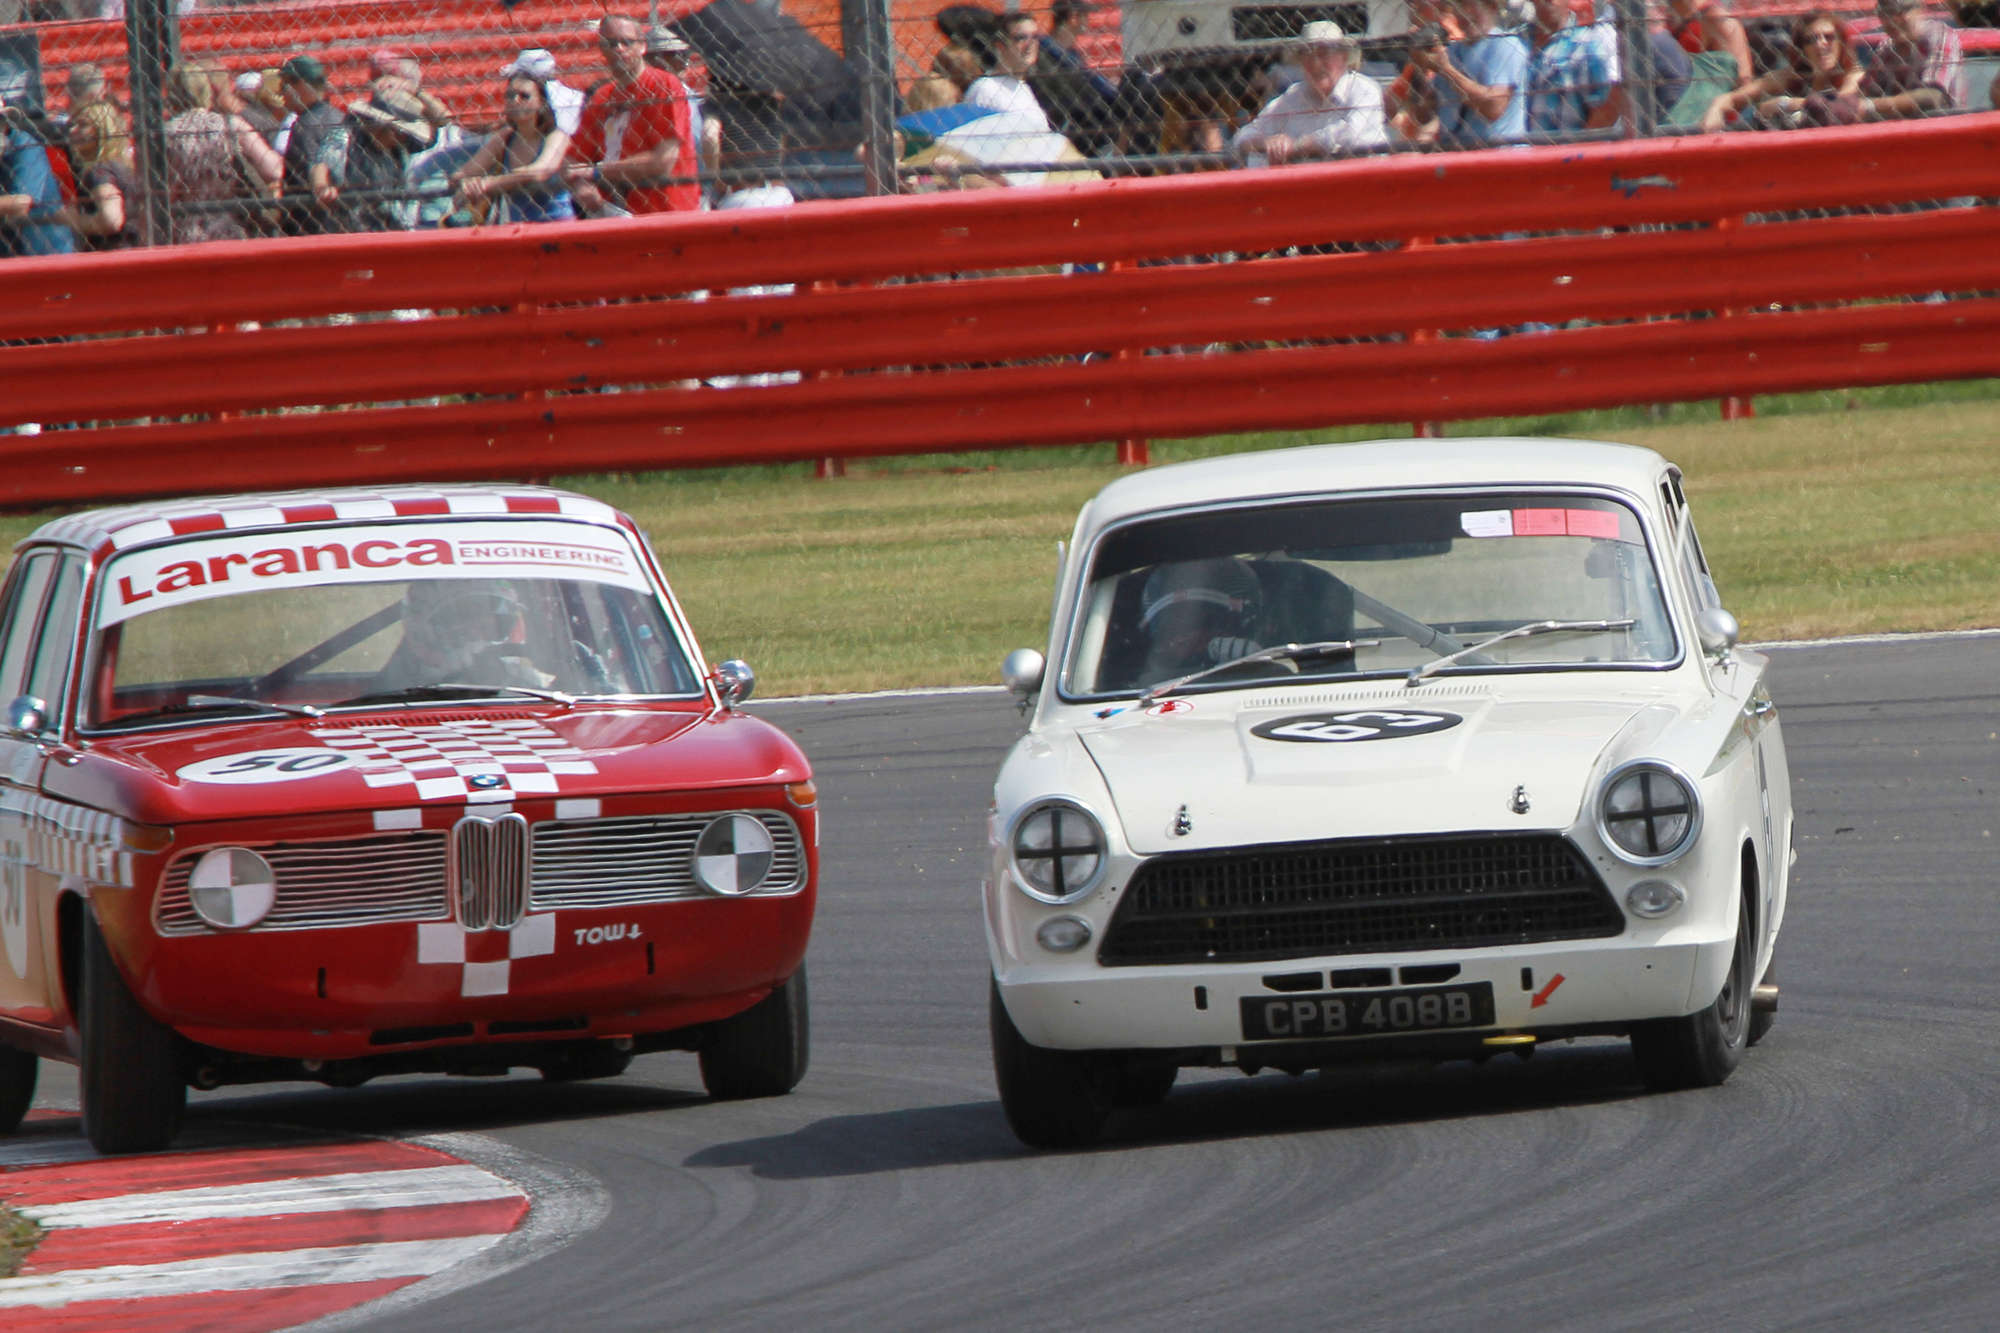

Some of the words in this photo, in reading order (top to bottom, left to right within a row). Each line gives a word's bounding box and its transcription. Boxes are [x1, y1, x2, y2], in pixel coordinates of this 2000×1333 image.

[118, 538, 454, 605] Laranca
[459, 546, 624, 567] ENGINEERING
[1270, 711, 1444, 740] 63
[207, 754, 347, 775] 50
[573, 923, 625, 946] TOW
[1264, 1001, 1347, 1035] CPB
[1361, 992, 1471, 1029] 408B
